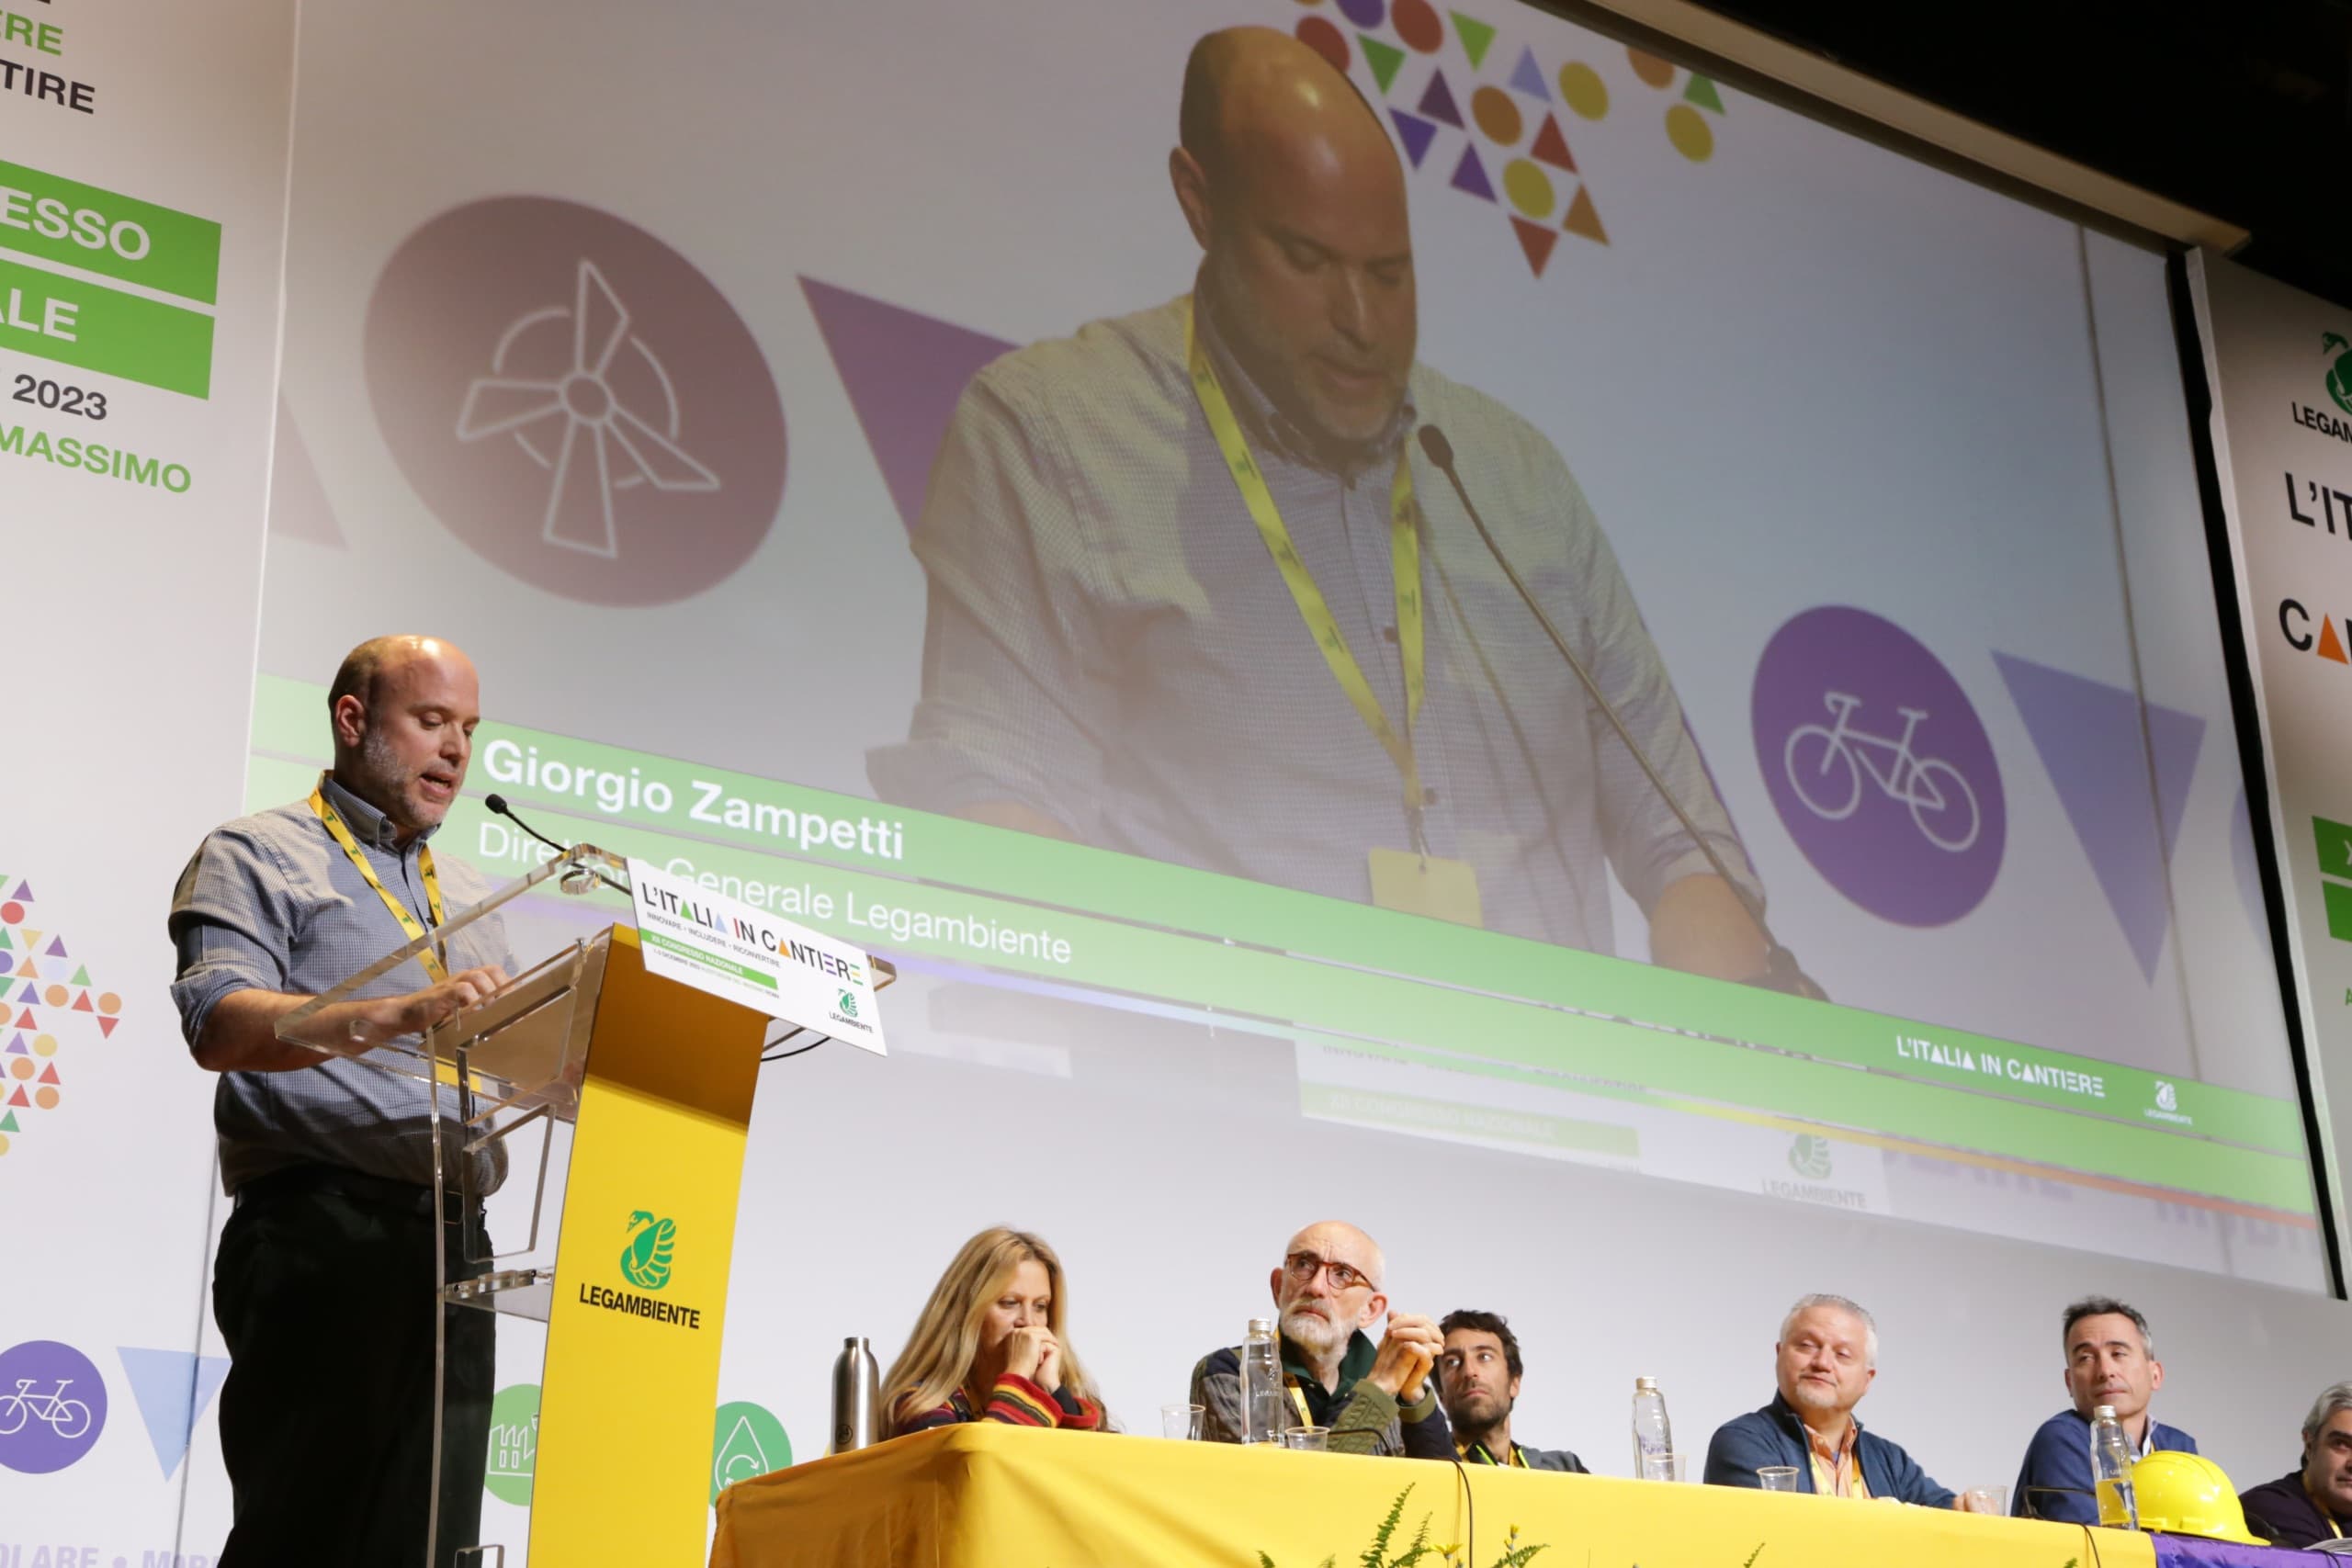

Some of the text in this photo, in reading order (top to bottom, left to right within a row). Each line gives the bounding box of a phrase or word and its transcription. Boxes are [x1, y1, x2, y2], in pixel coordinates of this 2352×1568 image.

[0, 9, 63, 56] RE
[0, 58, 96, 115] TIRE
[0, 185, 151, 261] ESSO
[0, 288, 79, 343] LE
[12, 364, 107, 421] 2023
[0, 421, 192, 493] MASSIMO
[483, 739, 904, 860] Giorgio Zampetti
[642, 882, 729, 934] L'ITALIA
[733, 918, 756, 945] IN
[762, 929, 865, 987] CANTIERE
[665, 858, 834, 919] Generale
[846, 891, 1073, 964] Legambiente
[829, 1010, 874, 1034] LEGAMBIENTE
[1895, 1034, 2106, 1098] L'ITALIA IN CANTIERE
[579, 1282, 701, 1330] LEGAMBIENTE
